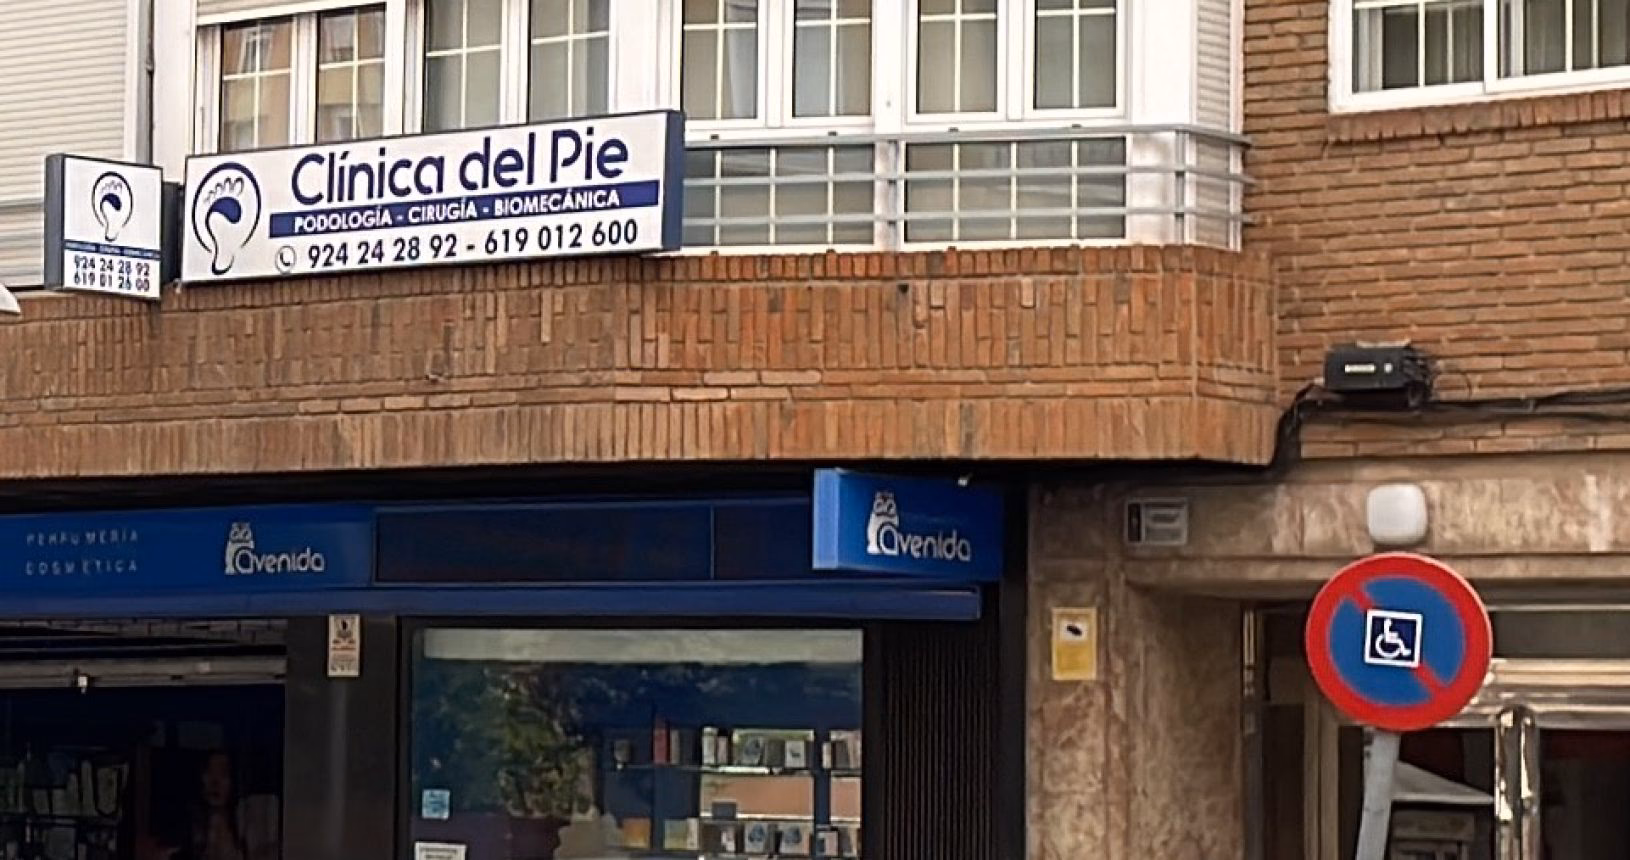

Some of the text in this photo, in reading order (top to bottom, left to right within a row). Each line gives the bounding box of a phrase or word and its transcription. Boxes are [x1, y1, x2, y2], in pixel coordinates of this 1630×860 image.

[291, 126, 630, 206] Clínica del Pie
[294, 204, 393, 233] PODOLOGÍA
[408, 197, 477, 223] CIRUGÍA
[494, 188, 620, 216] BIOMECÁNICA
[74, 254, 150, 277] 924 24 28 92
[308, 242, 349, 269] 924
[357, 239, 384, 265] 24
[393, 236, 420, 262] 28
[430, 233, 457, 259] 92
[484, 226, 529, 254] 619
[538, 223, 582, 250] 012
[592, 218, 638, 246] 600
